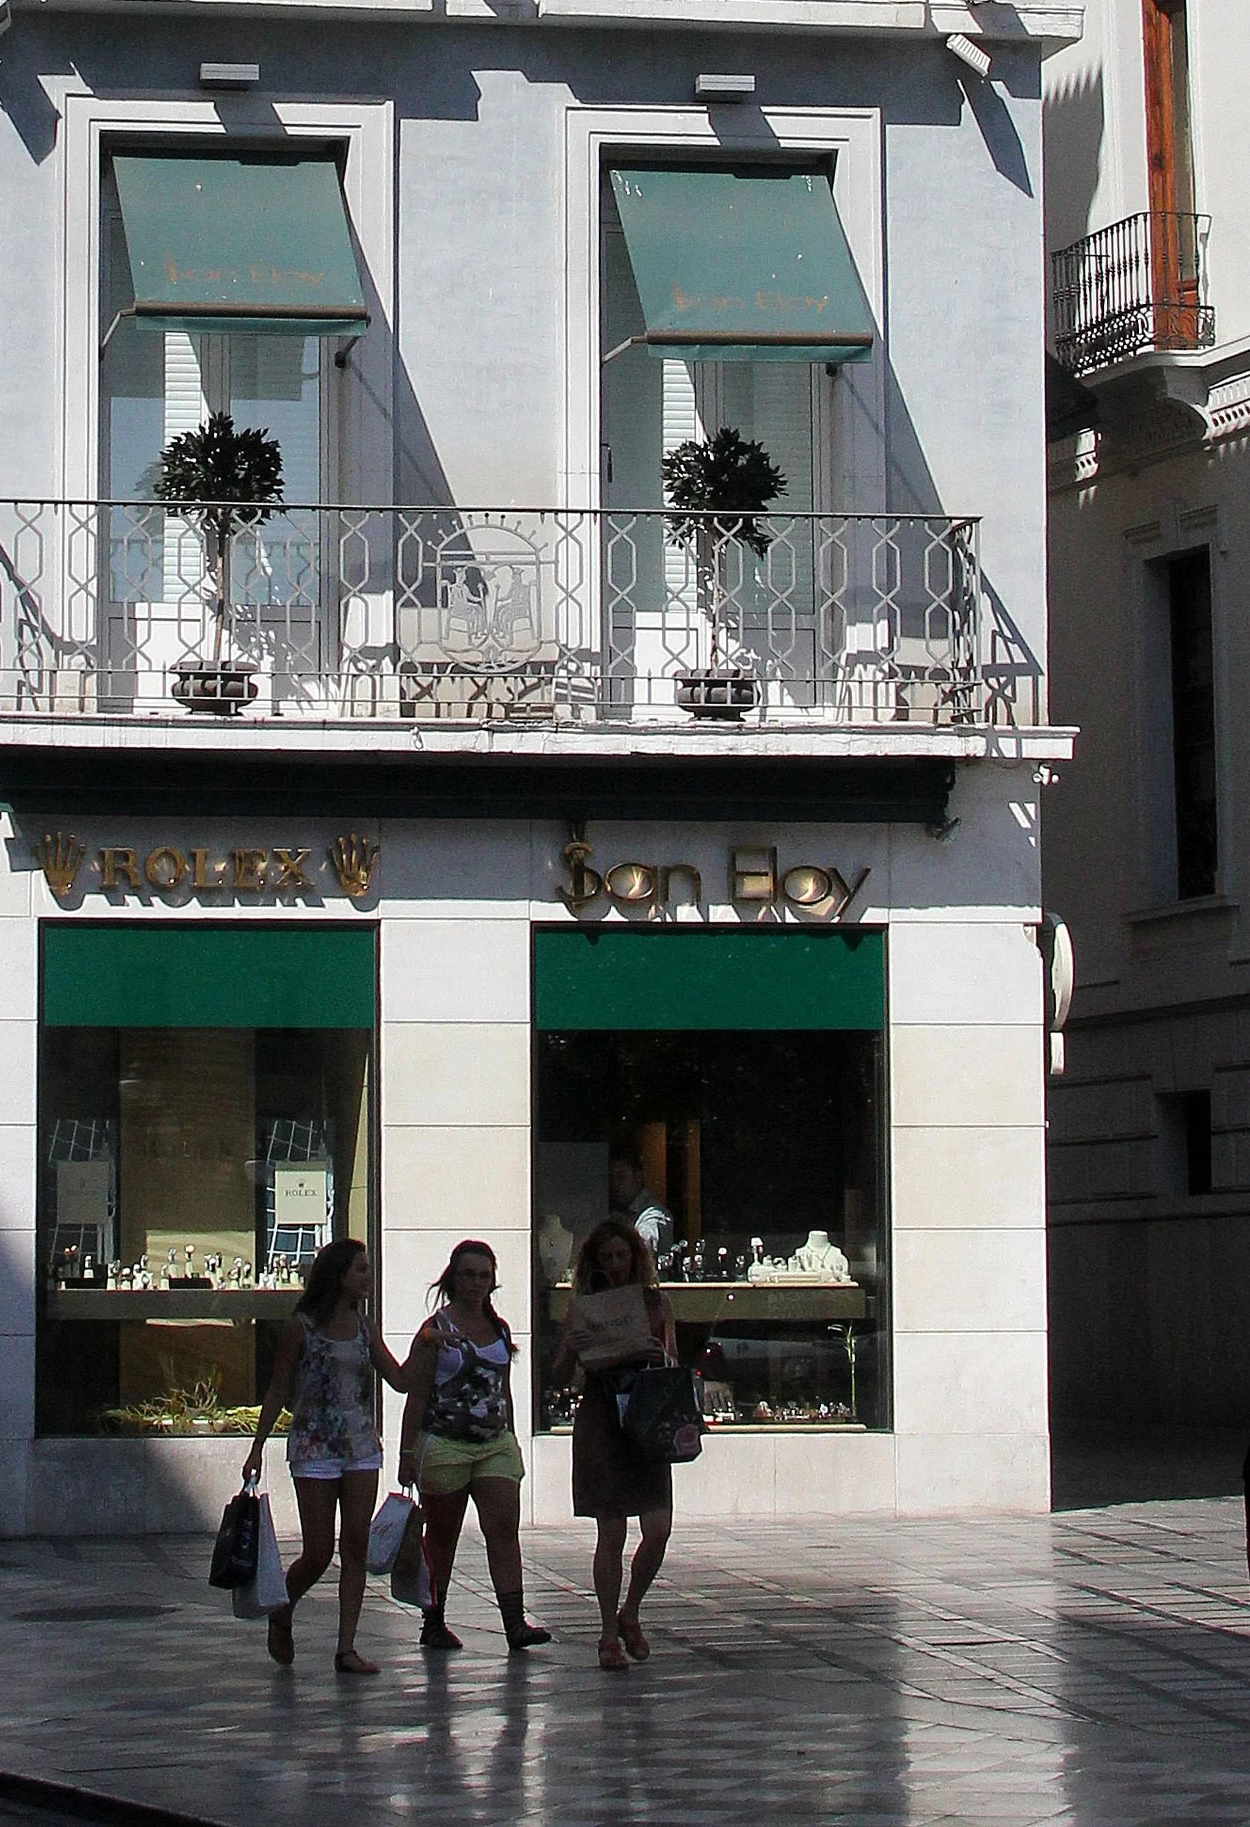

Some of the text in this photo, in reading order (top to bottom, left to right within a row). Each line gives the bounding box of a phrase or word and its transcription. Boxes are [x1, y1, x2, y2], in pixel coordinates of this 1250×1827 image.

[99, 847, 314, 891] ROLEX
[731, 845, 873, 920] Eloy
[284, 1189, 317, 1197] ROLEX
